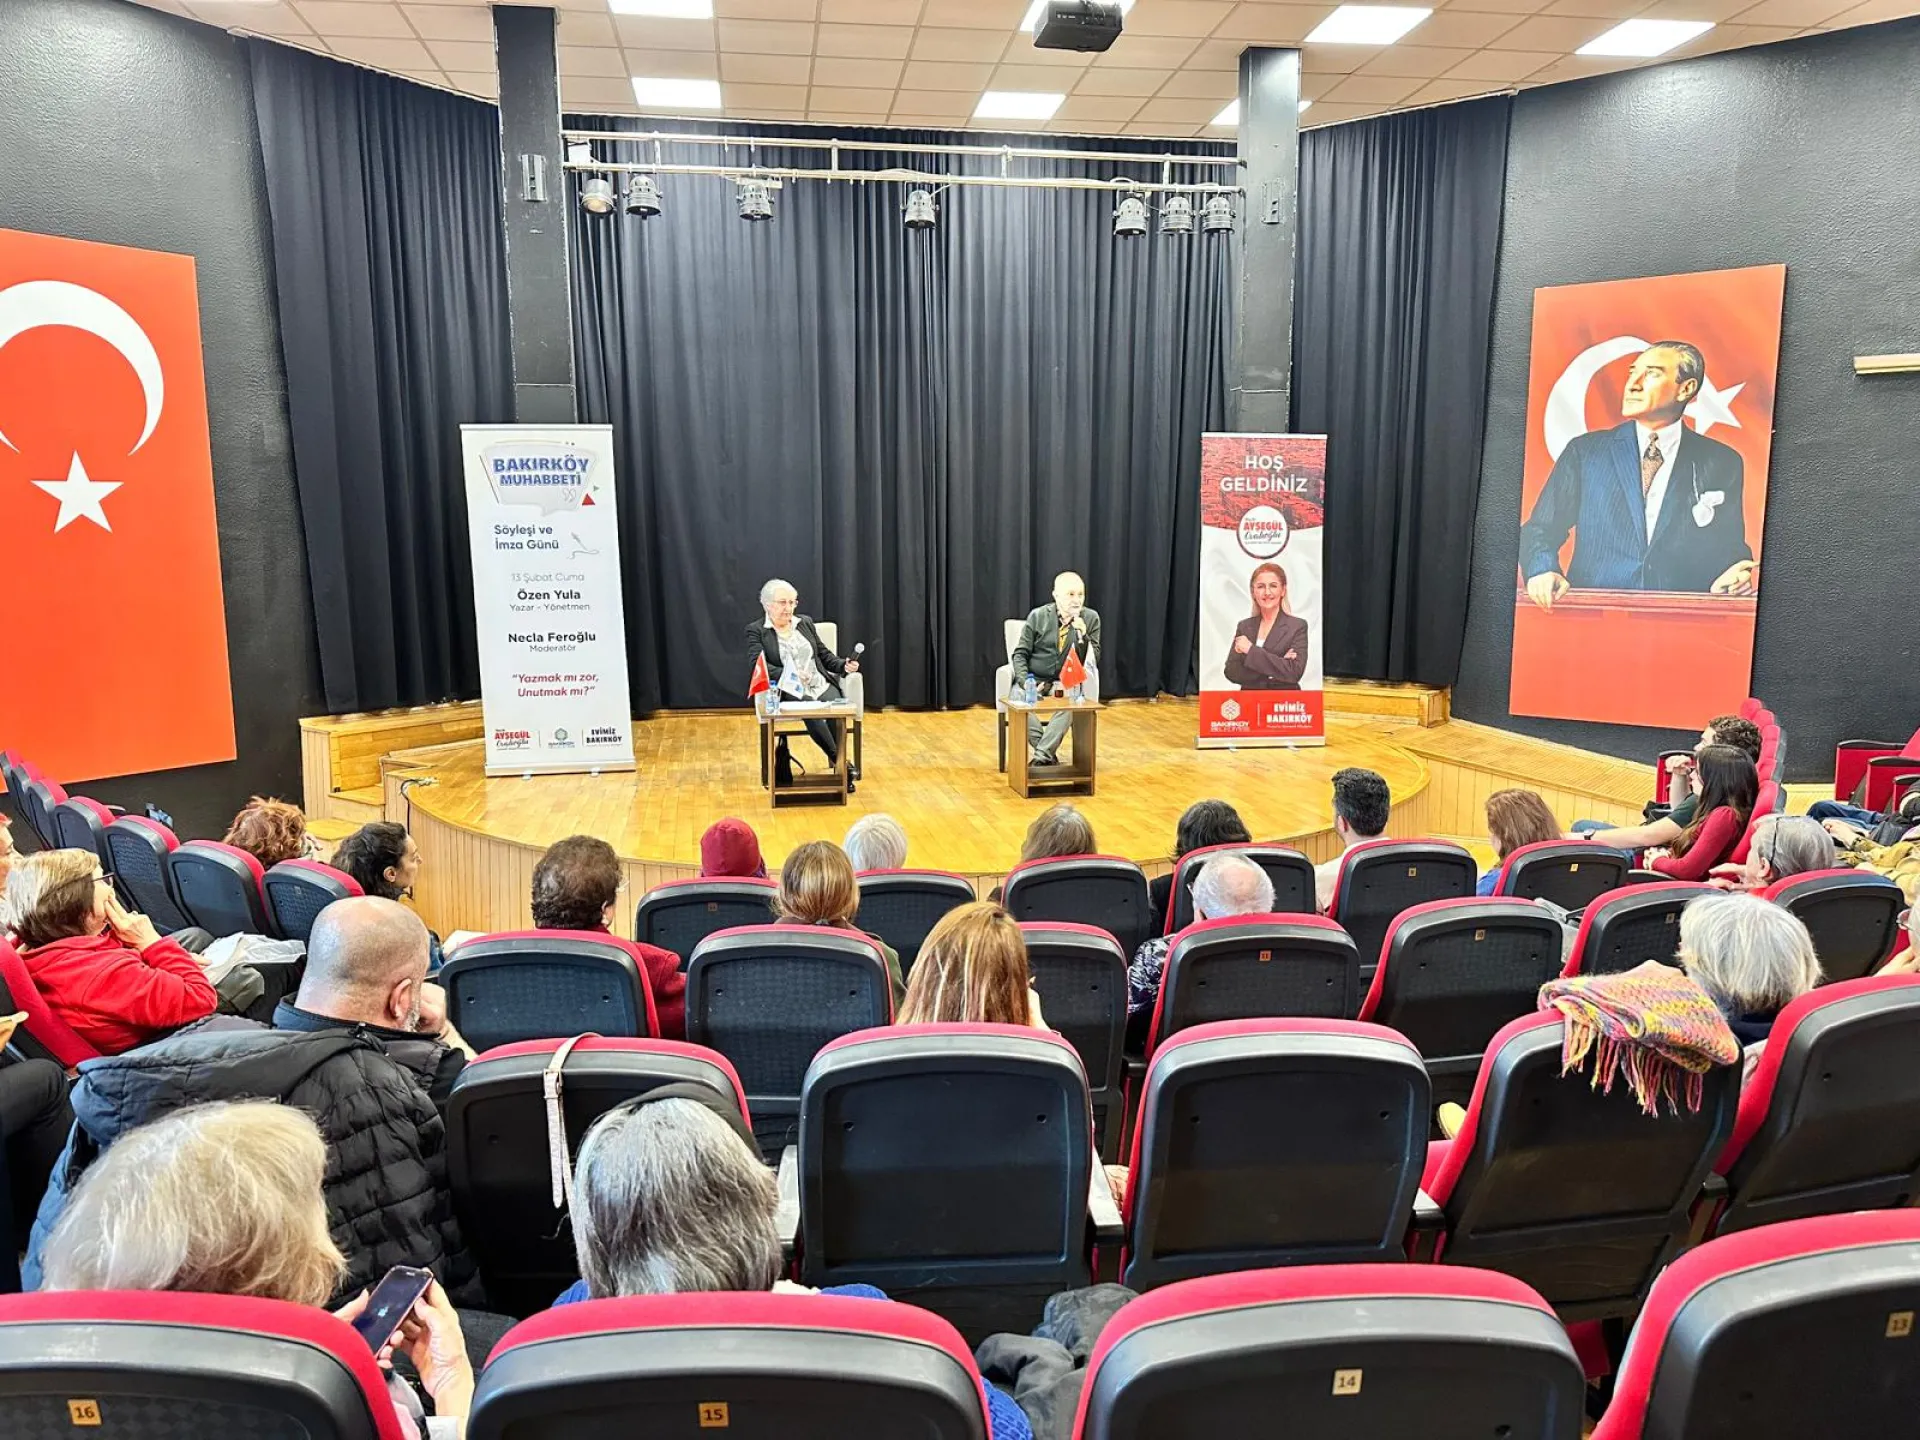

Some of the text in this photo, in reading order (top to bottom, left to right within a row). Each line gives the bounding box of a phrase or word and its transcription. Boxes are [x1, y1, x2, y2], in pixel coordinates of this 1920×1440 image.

[493, 455, 589, 473] BAKIRKÖY
[1245, 455, 1284, 472] HOŞ
[500, 472, 581, 485] MUHABBETİ
[1220, 474, 1308, 492] GELDİNİZ
[494, 525, 553, 537] Söyleşi ve
[495, 538, 559, 550] İmza Günü
[512, 573, 585, 584] 13 Şubat Cuma
[517, 588, 581, 600] Özen Yula
[544, 602, 591, 611] Yönetmen
[508, 631, 596, 643] Necla Feroğlu
[529, 644, 577, 653] Moderatör
[564, 674, 577, 682] mı
[579, 674, 599, 683] zor,
[518, 687, 567, 697] Unutmak
[1274, 701, 1305, 712] EVİMİZ
[1893, 1319, 1909, 1331] 13
[1337, 1376, 1355, 1388] 14
[75, 1406, 95, 1419] 16
[705, 1409, 723, 1421] 15
